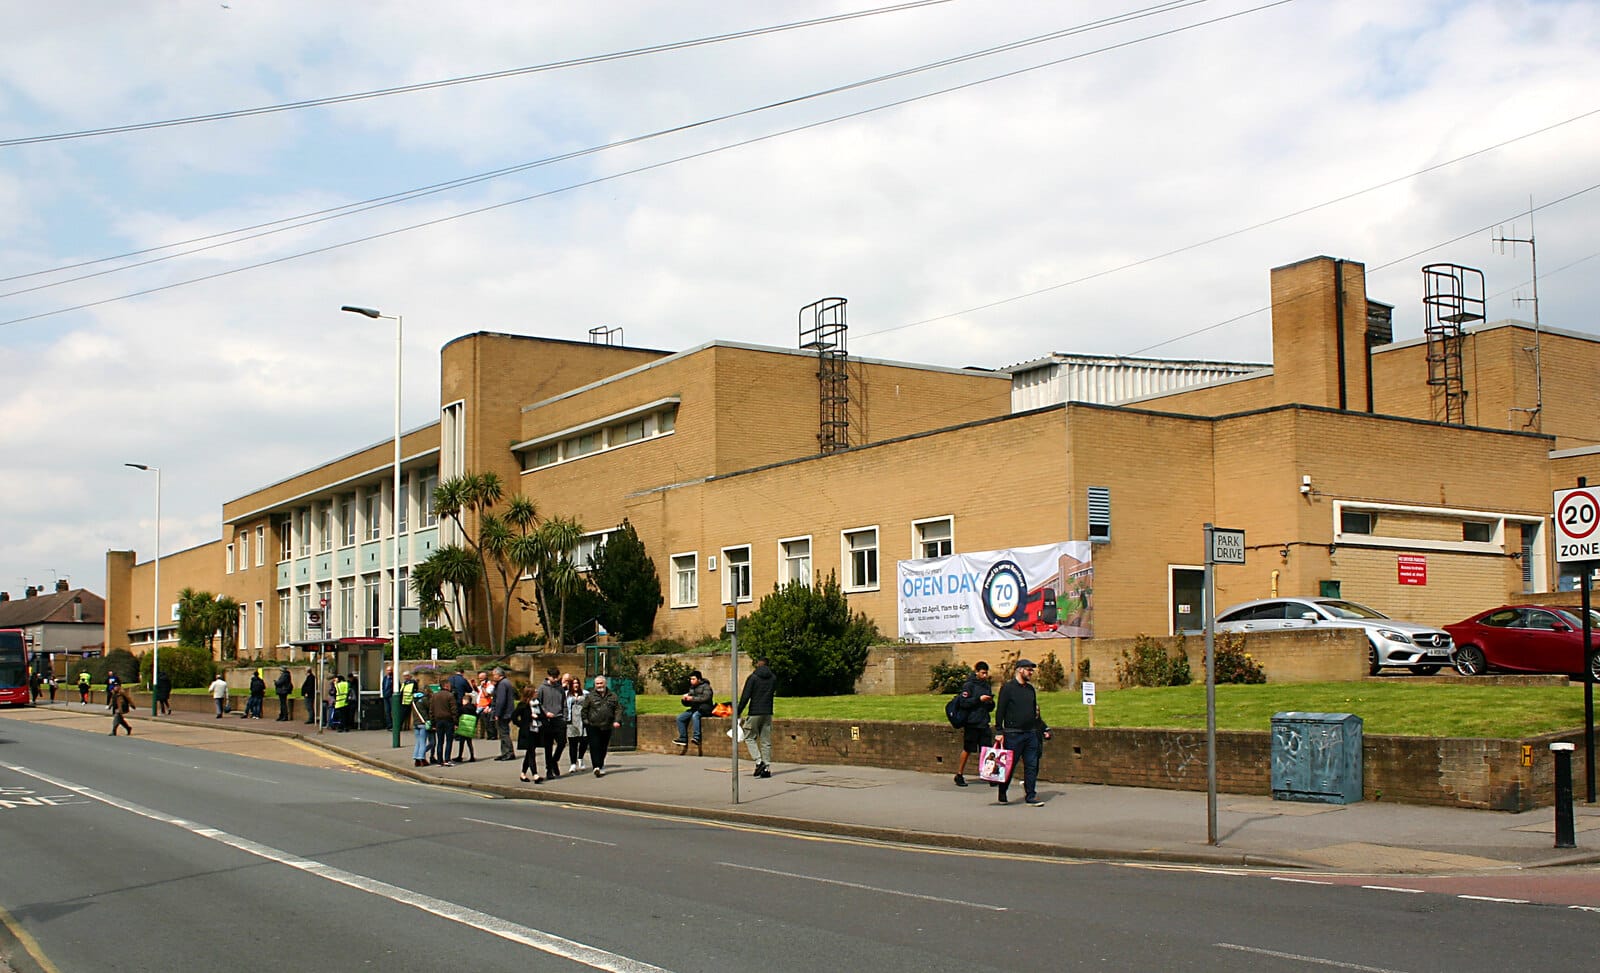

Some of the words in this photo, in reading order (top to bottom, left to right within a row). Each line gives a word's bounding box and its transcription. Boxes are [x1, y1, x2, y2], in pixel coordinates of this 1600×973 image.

[1565, 504, 1594, 525] 20
[1217, 535, 1240, 547] PARK
[1217, 547, 1242, 560] DRIVE
[1561, 542, 1599, 557] ZONE
[903, 575, 943, 598] OPEN
[947, 572, 981, 594] DAY
[995, 583, 1013, 601] 70
